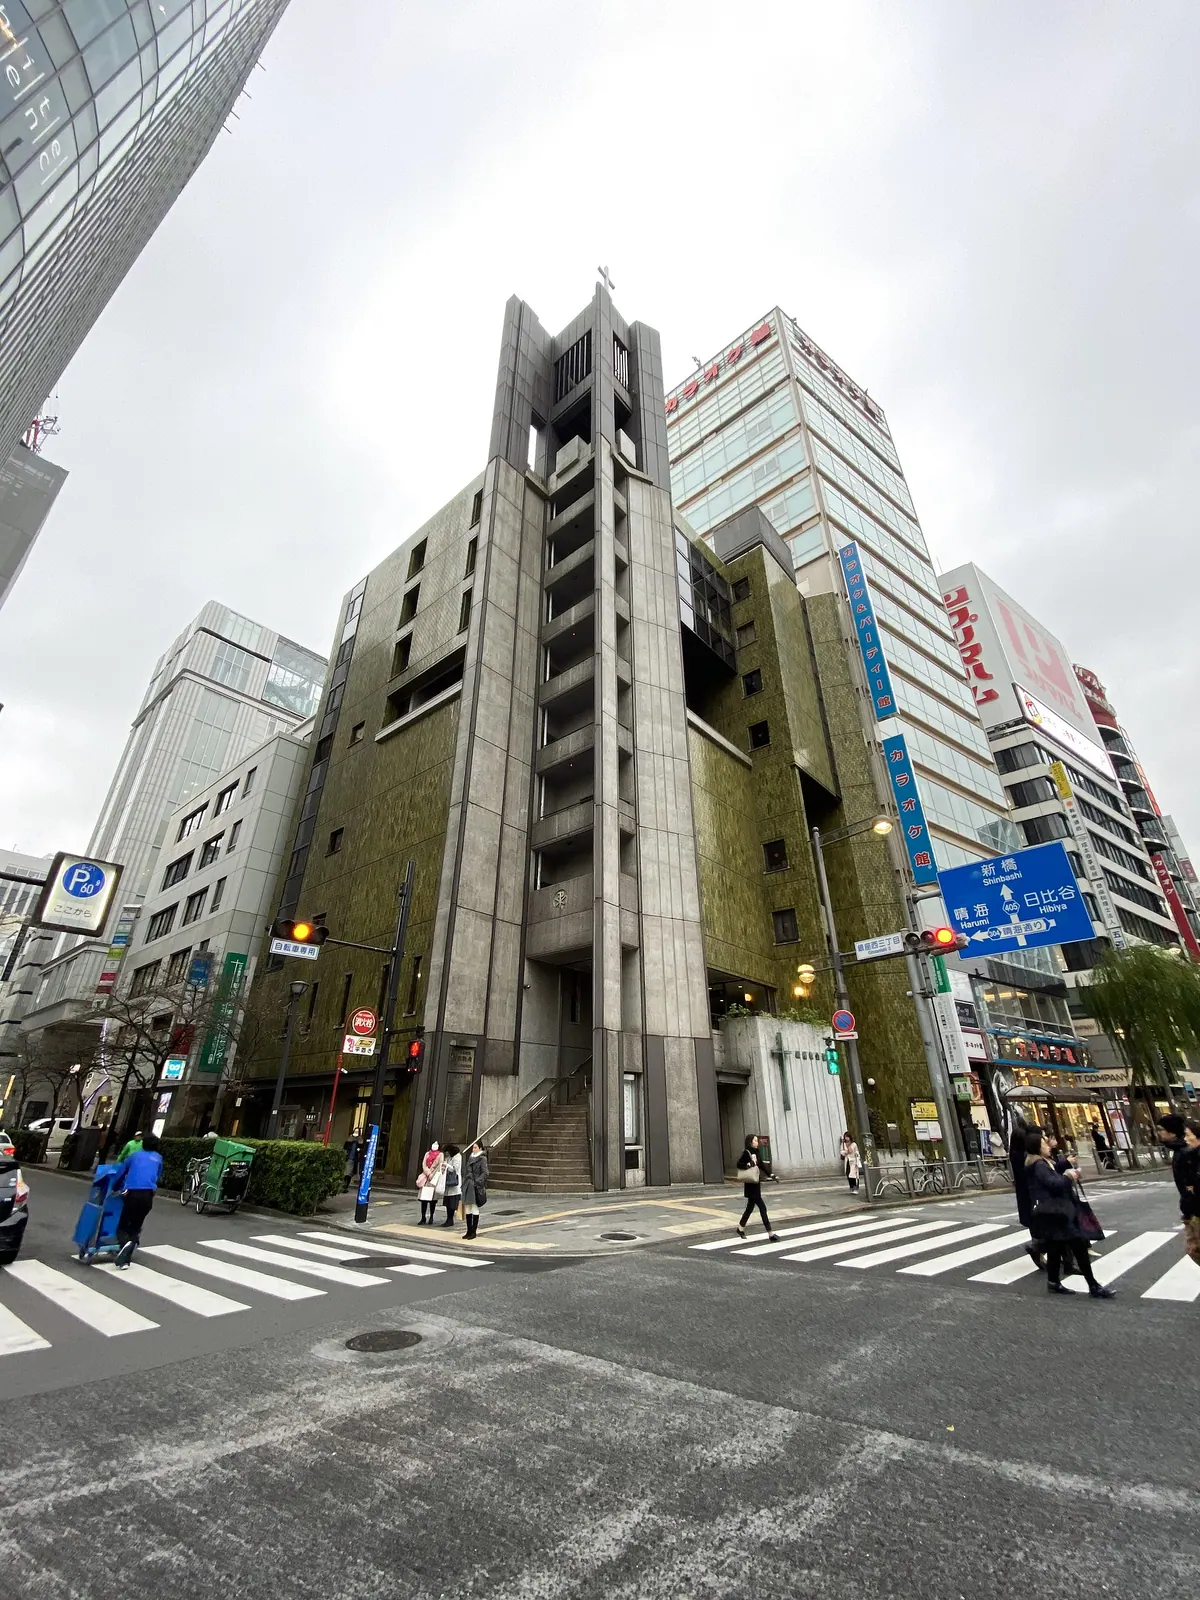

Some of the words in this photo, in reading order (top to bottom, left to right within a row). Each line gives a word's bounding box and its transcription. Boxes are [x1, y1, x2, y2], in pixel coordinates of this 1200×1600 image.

[890, 749, 931, 867] カラオケ館
[981, 858, 1018, 877] 新橋
[69, 869, 90, 890] P
[983, 871, 1023, 887] Shinbashi
[1023, 885, 1076, 908] 日比谷
[54, 904, 92, 918] ここから
[954, 903, 989, 921] 晴海
[1004, 902, 1018, 912] 405
[1039, 903, 1067, 915] Hibiya
[960, 917, 990, 930] Harumi
[1002, 920, 1043, 936] 晴海通り
[275, 942, 316, 957] 自転車専用
[355, 1017, 374, 1028] 消火栓
[1084, 1073, 1129, 1083] COMPANY
